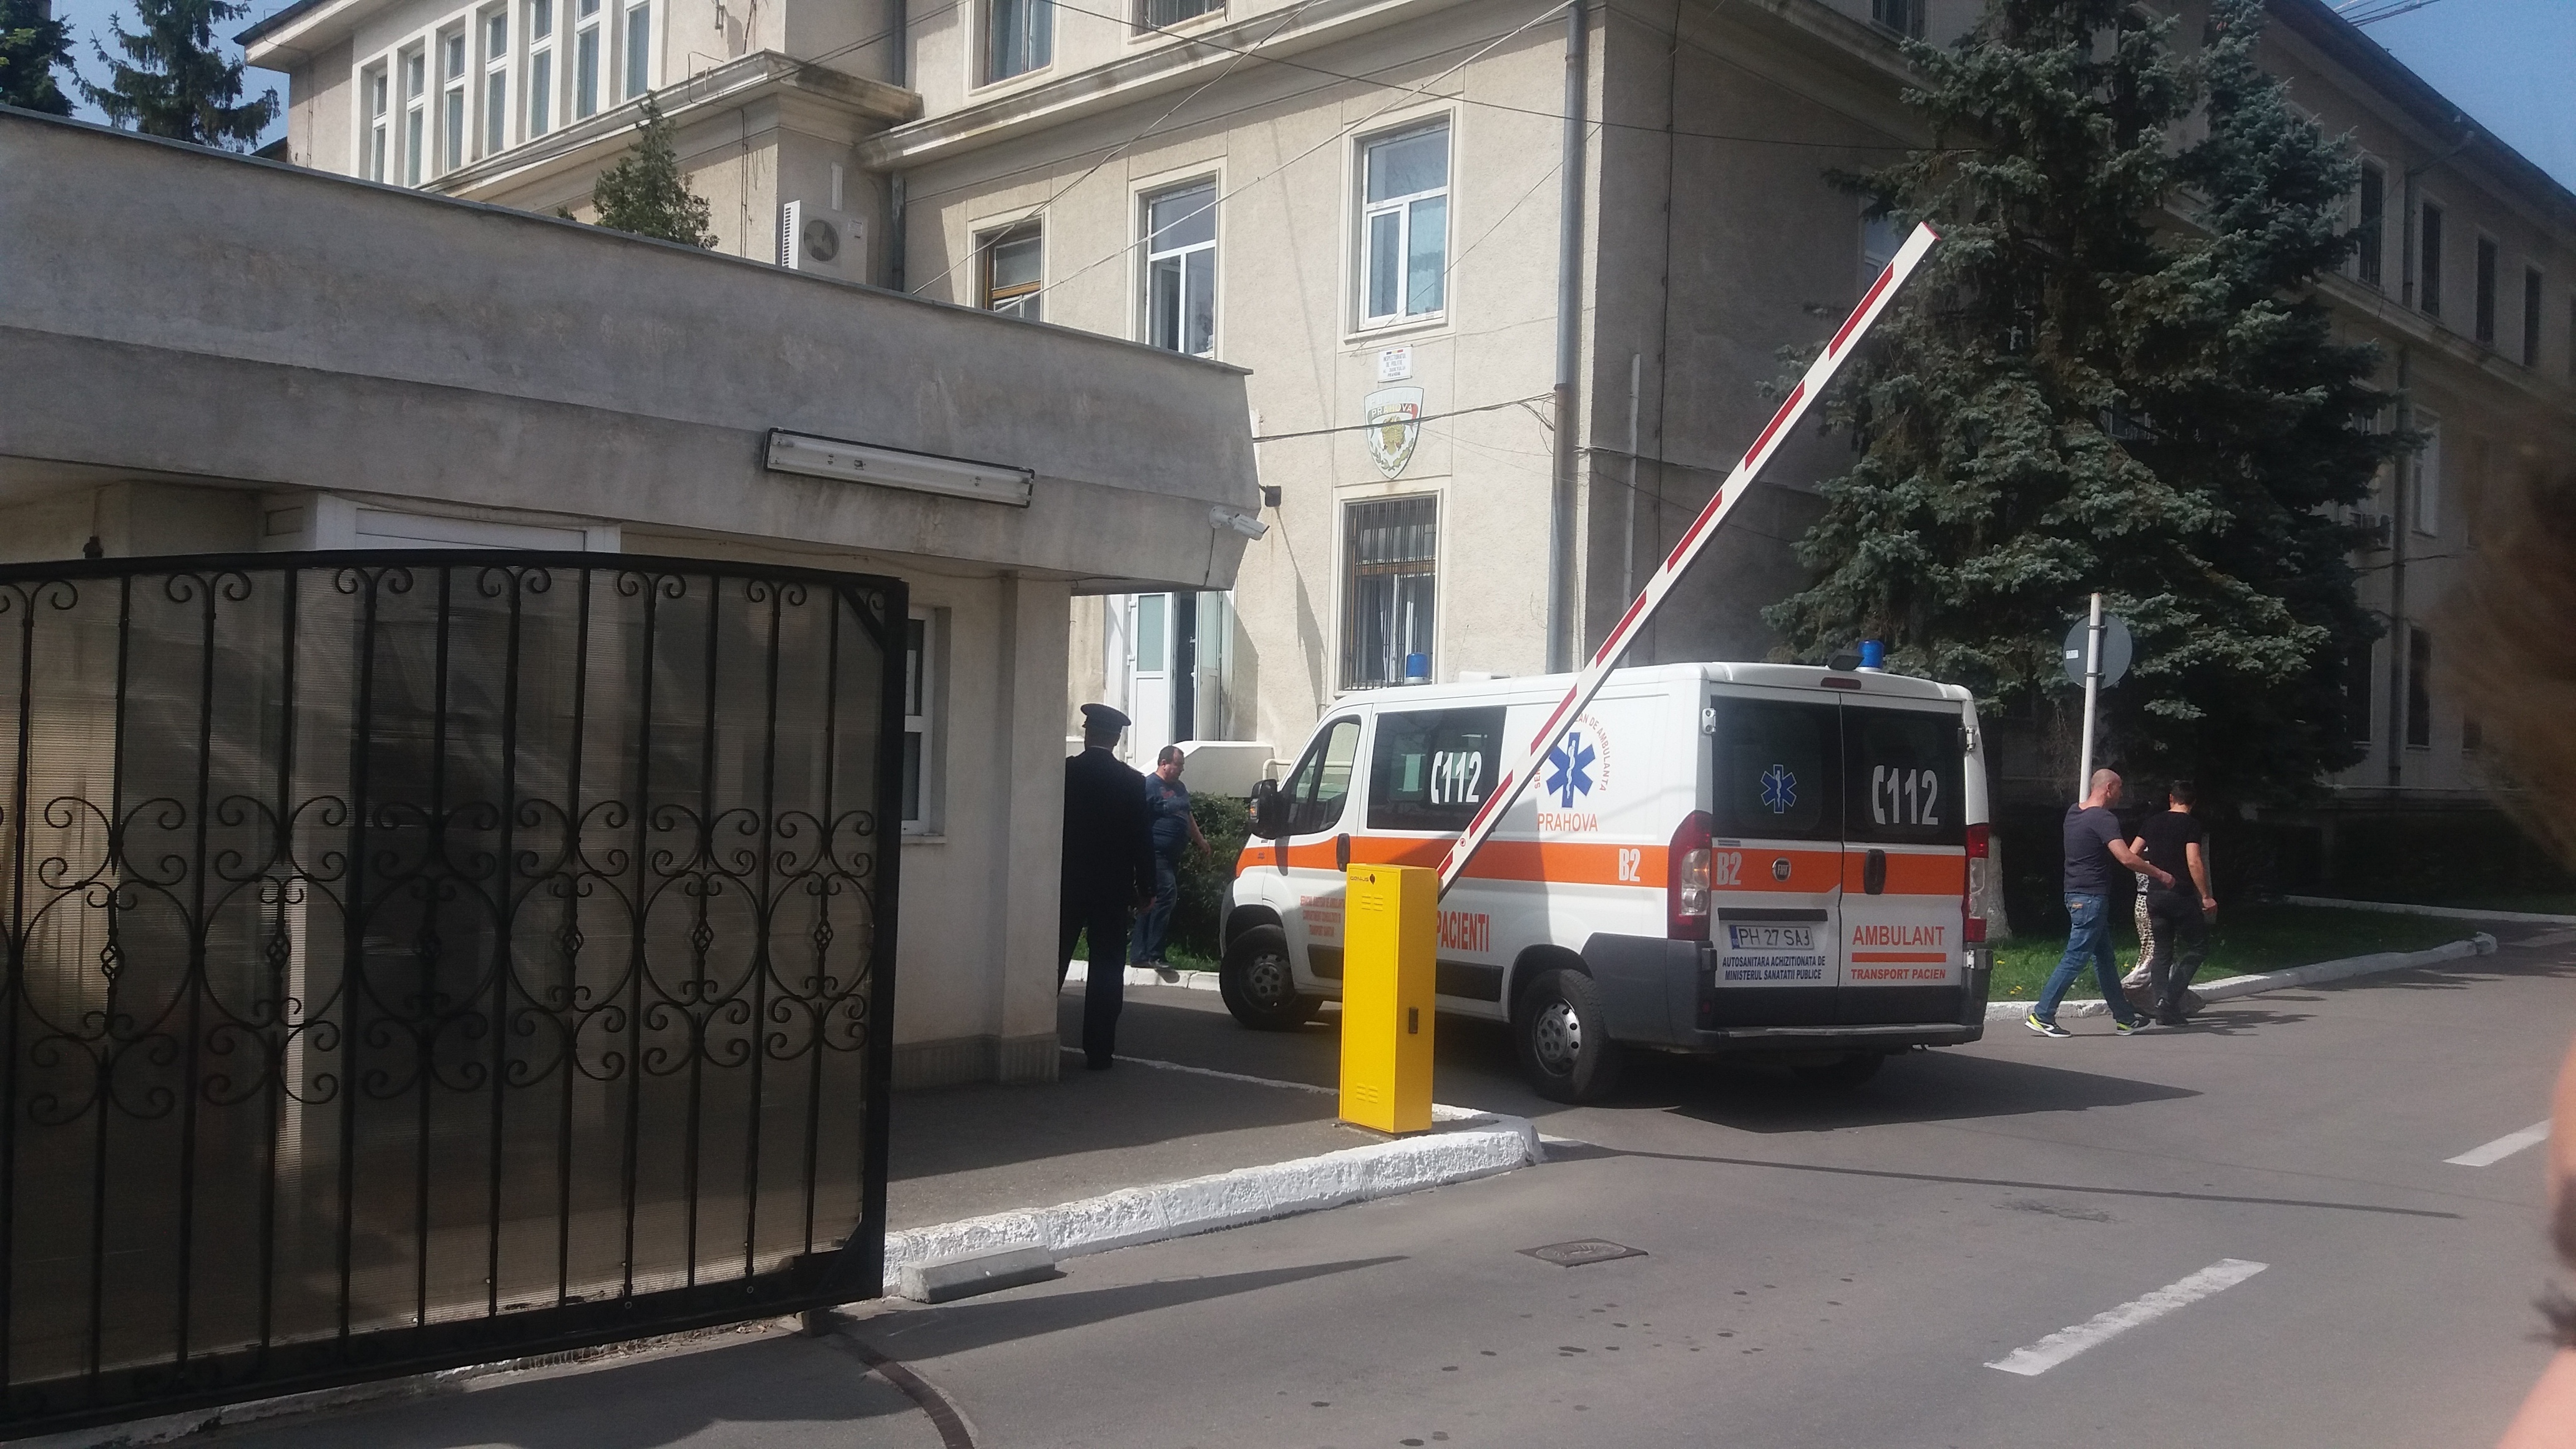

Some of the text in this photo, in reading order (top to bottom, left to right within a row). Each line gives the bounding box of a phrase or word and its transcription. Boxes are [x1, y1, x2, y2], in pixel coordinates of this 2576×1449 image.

[1372, 404, 1413, 417] PRAHOVA
[1589, 716, 1599, 731] DE
[1538, 813, 1598, 832] PRAHOVA
[1619, 848, 1641, 882] B2
[1717, 852, 1742, 885] B2
[1437, 910, 1490, 953] PACIENTI
[1739, 928, 1760, 945] PH
[1764, 929, 1779, 946] 27
[1852, 925, 1945, 946] AMBULANT
[1722, 955, 1826, 967] AUTOSANITARA ACHIZITIONATA DE
[1725, 968, 1822, 980] MINISTERUL SANATATII PUBLICE
[1851, 968, 1946, 980] TRANSPORT PACIEN
